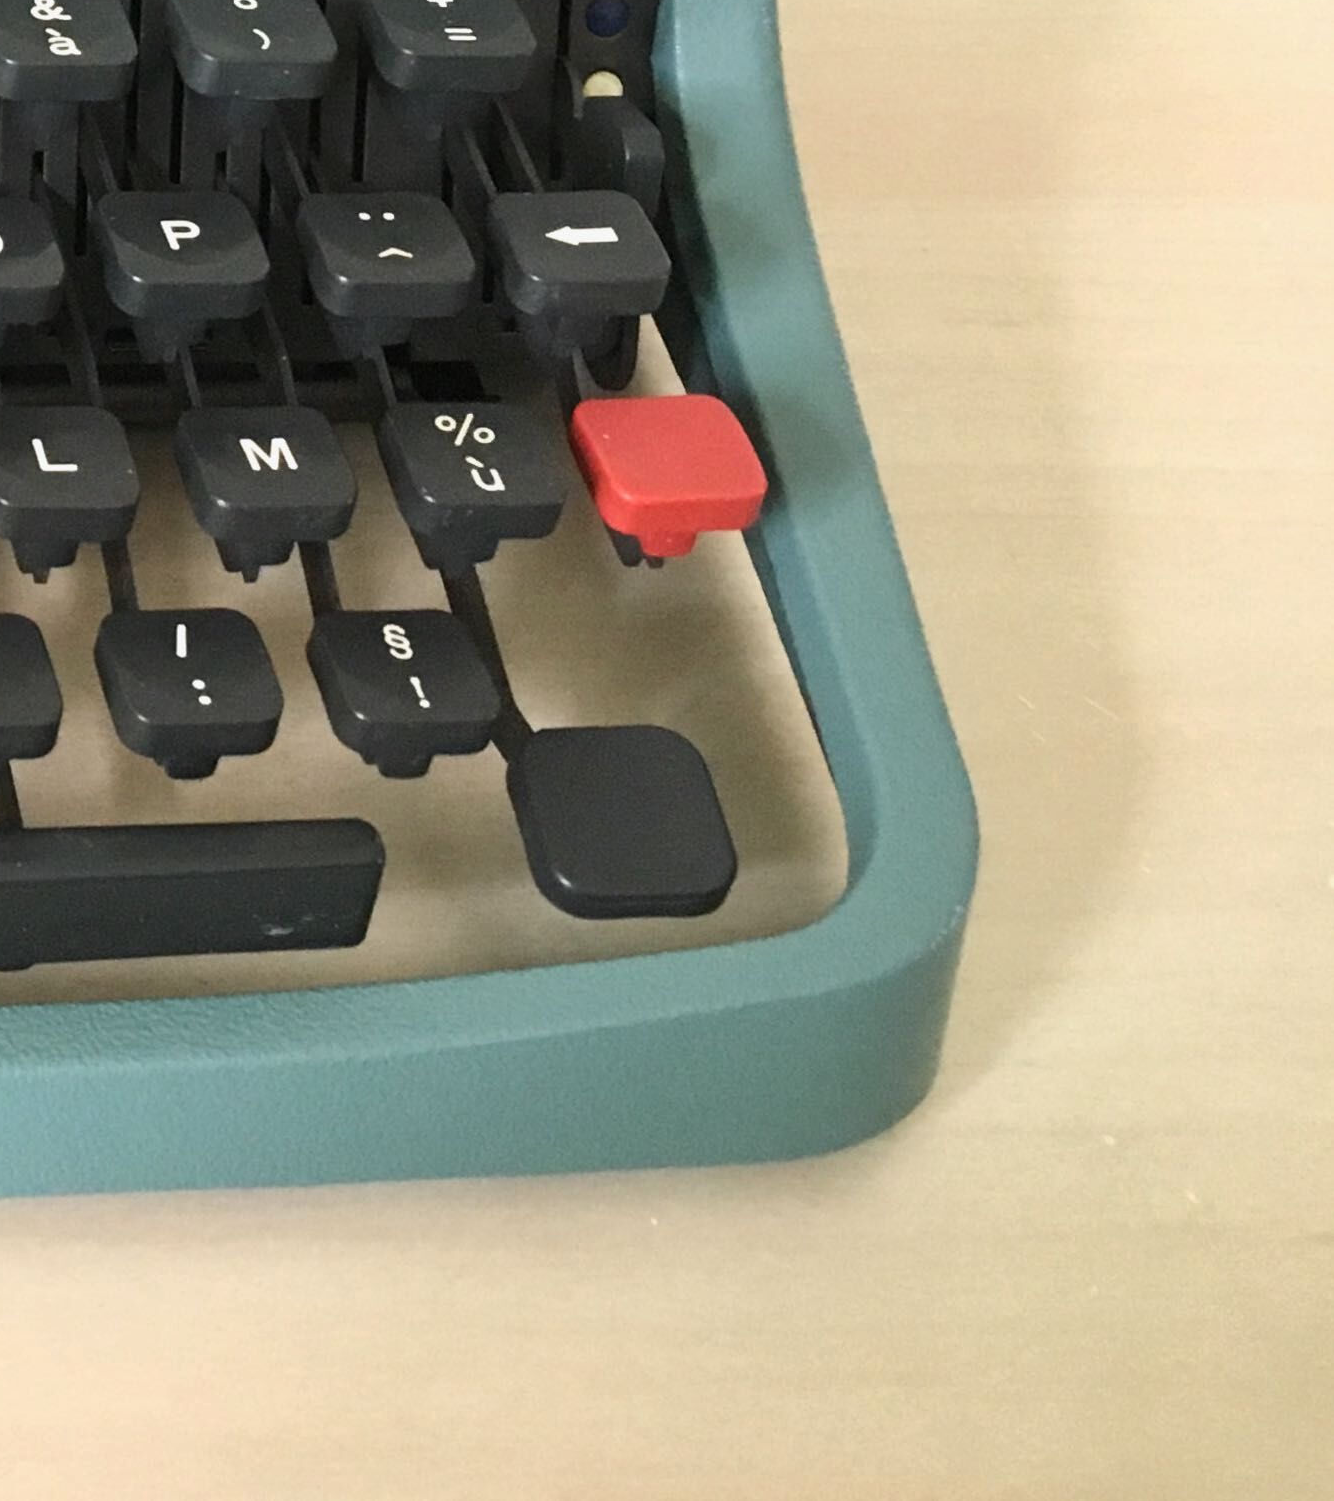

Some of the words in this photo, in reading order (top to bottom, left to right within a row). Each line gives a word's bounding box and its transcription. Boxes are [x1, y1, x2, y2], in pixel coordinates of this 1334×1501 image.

[45, 27, 82, 56] à
[160, 219, 201, 251] P
[434, 413, 496, 446] %
[31, 438, 79, 473] L
[239, 437, 299, 472] M
[465, 456, 506, 492] ù
[382, 623, 414, 660] §
[191, 679, 213, 706] :
[409, 676, 431, 709] !
